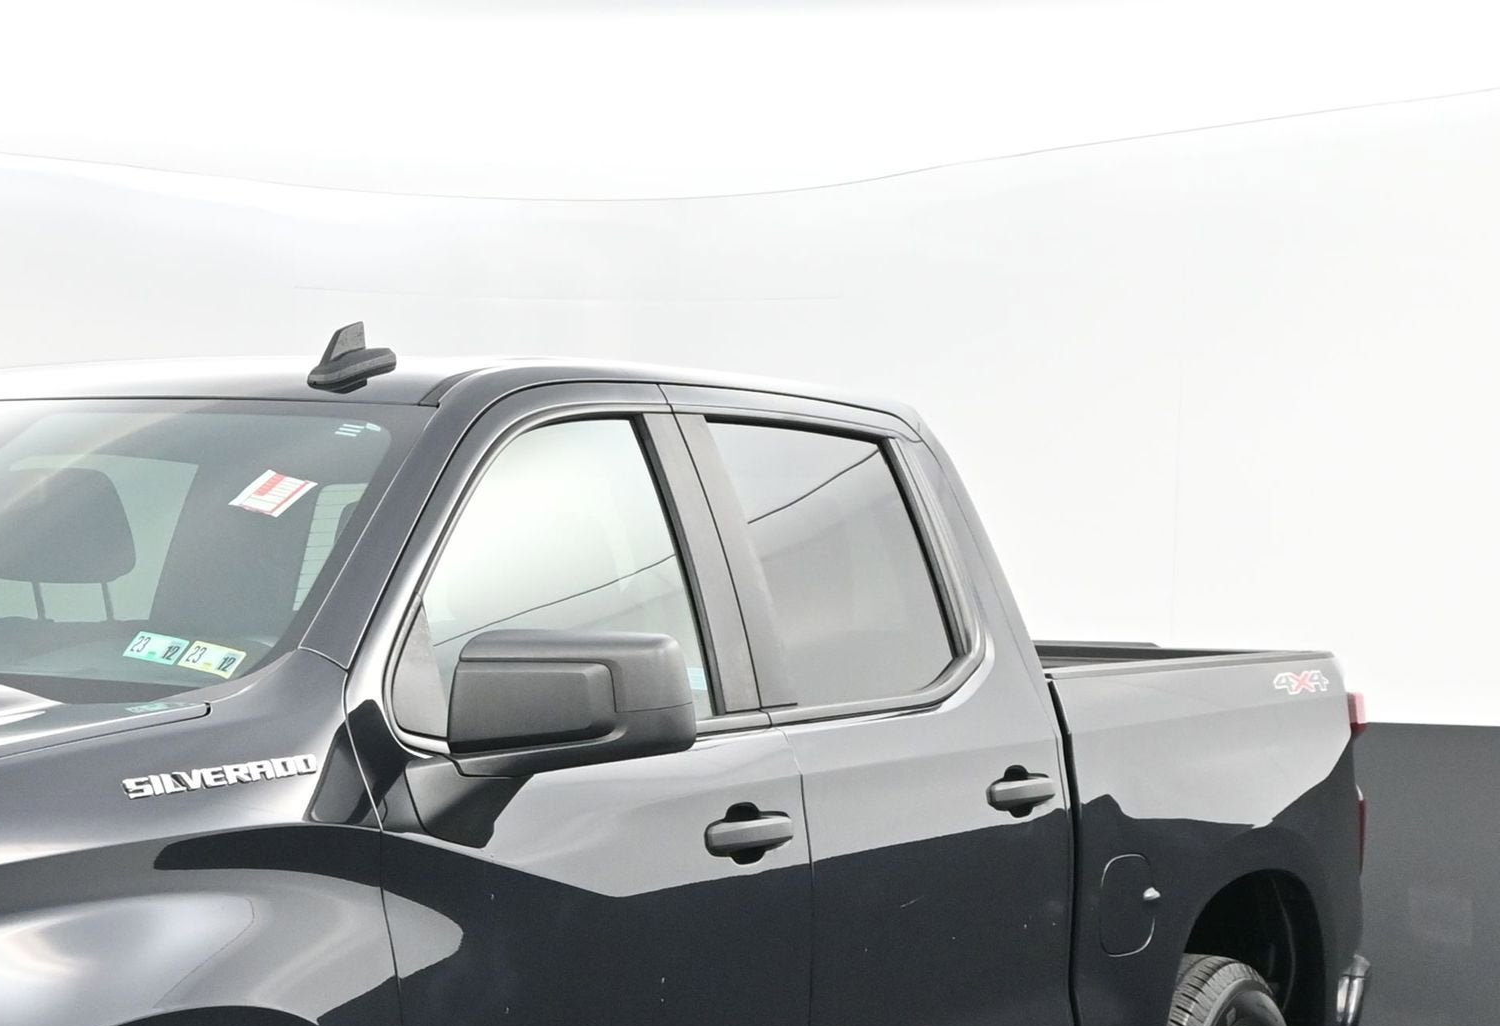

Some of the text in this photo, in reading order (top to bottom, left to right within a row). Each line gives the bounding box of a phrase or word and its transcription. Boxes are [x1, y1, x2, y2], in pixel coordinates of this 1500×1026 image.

[130, 635, 181, 661] 23 12
[185, 645, 237, 672] 23 12
[121, 754, 318, 799] SILVERADO
